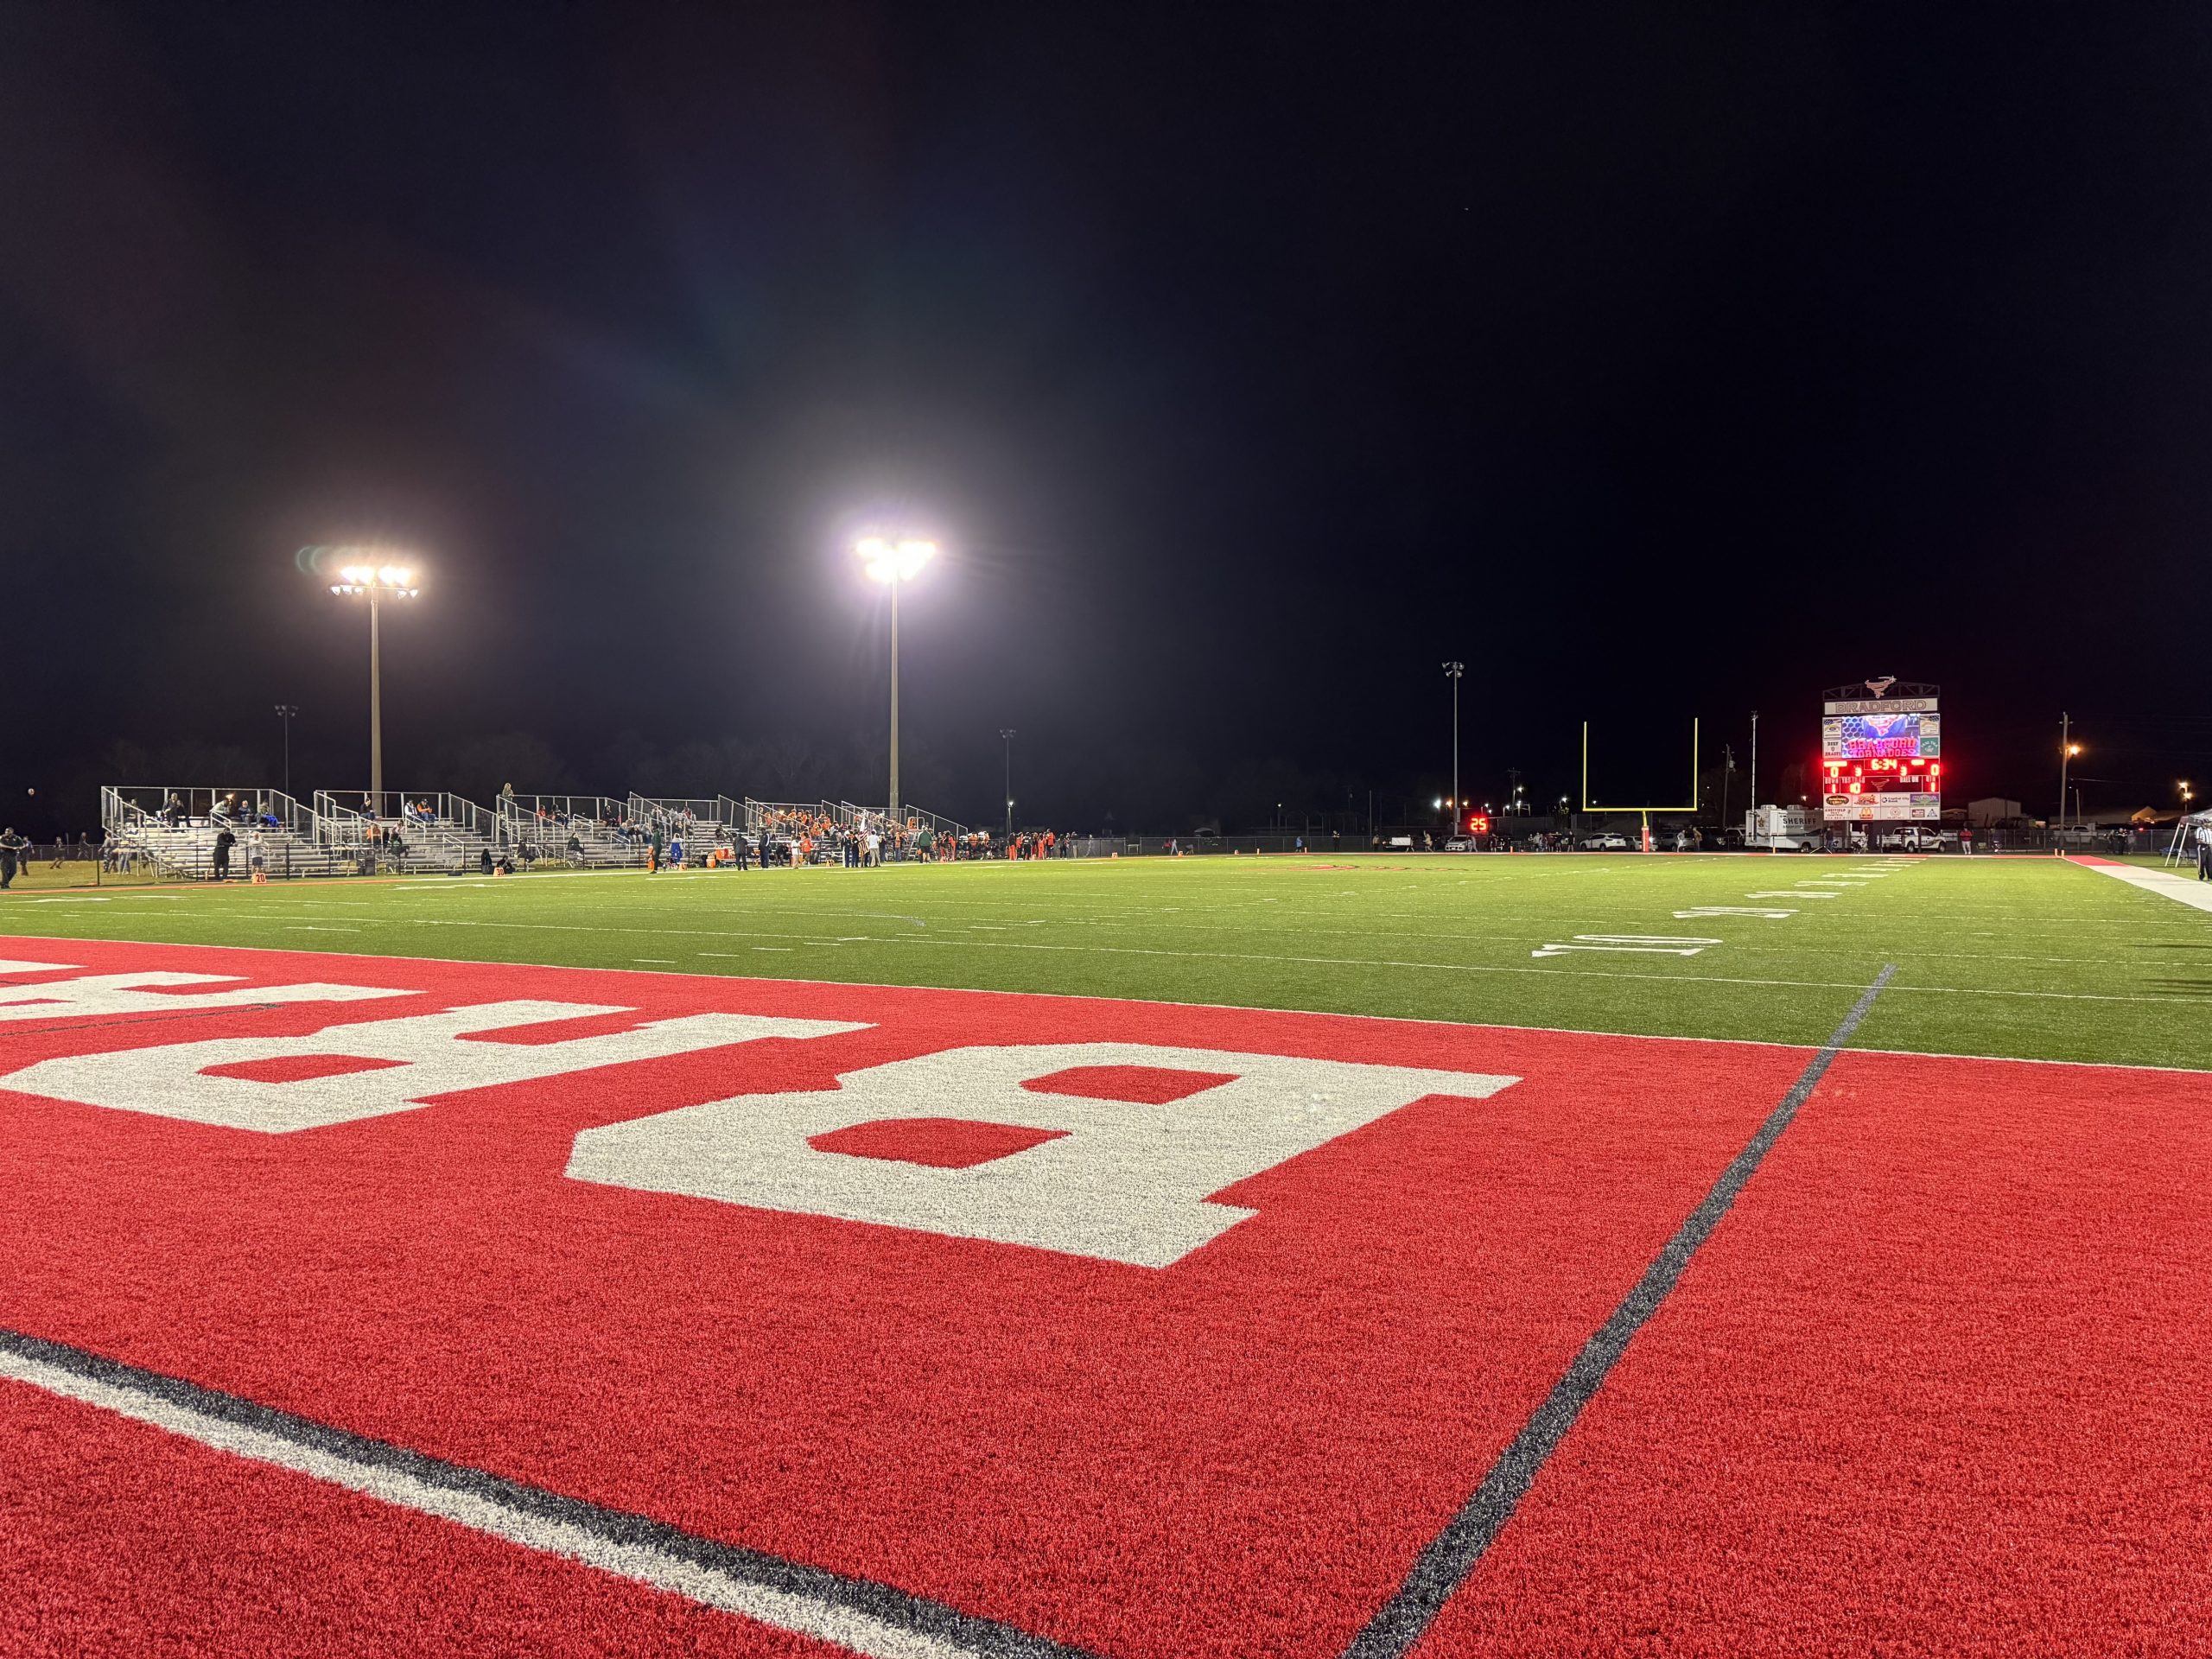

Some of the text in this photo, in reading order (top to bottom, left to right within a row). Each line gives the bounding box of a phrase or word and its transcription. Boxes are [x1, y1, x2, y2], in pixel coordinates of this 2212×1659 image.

[1835, 700, 1927, 714] BRADFORD
[1871, 759, 1897, 770] 6:34
[1830, 766, 1839, 778] 0
[1855, 767, 1862, 777] 3
[1901, 766, 1907, 776] 3
[1930, 765, 1939, 776] 0
[1471, 818, 1486, 830] 25
[256, 874, 265, 882] 20
